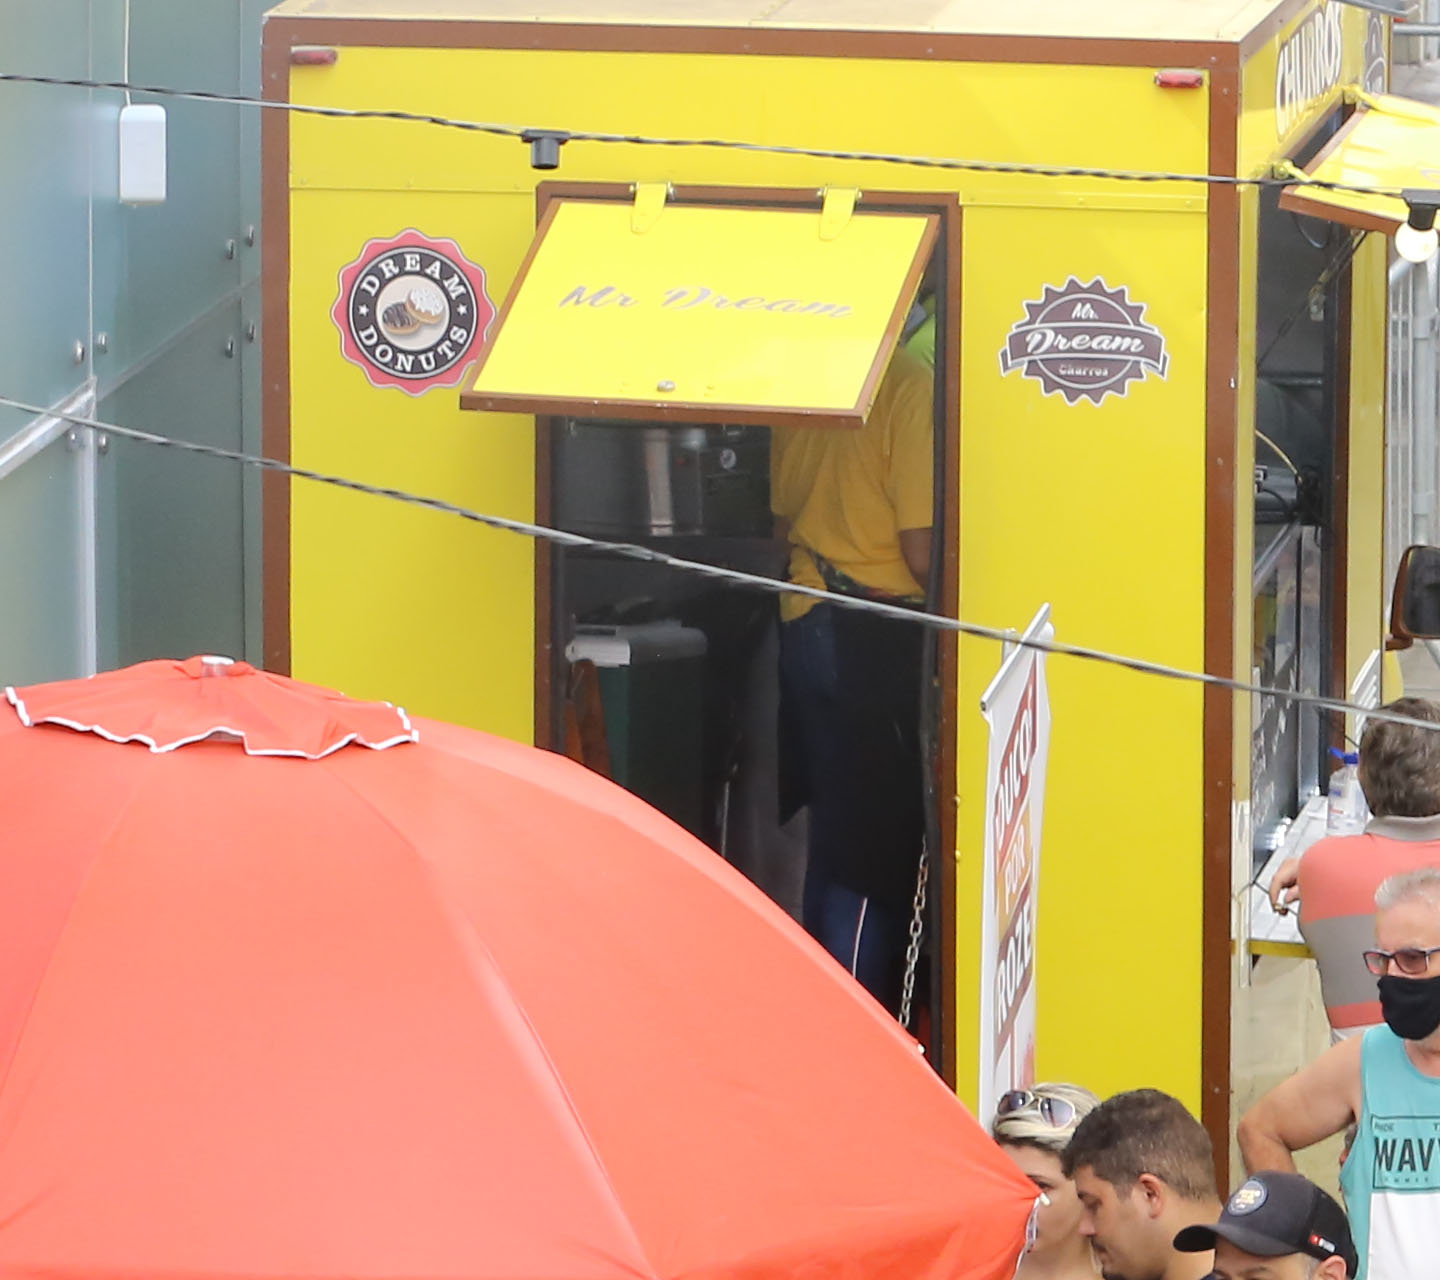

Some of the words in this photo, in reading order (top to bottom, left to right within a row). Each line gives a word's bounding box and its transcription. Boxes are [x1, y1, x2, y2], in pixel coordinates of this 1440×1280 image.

[1276, 0, 1342, 136] CHURROS
[360, 253, 467, 301] DREAM
[558, 284, 640, 310] Mr
[660, 284, 856, 319] Dream
[358, 324, 468, 372] DONUTS
[1025, 327, 1145, 355] Dream
